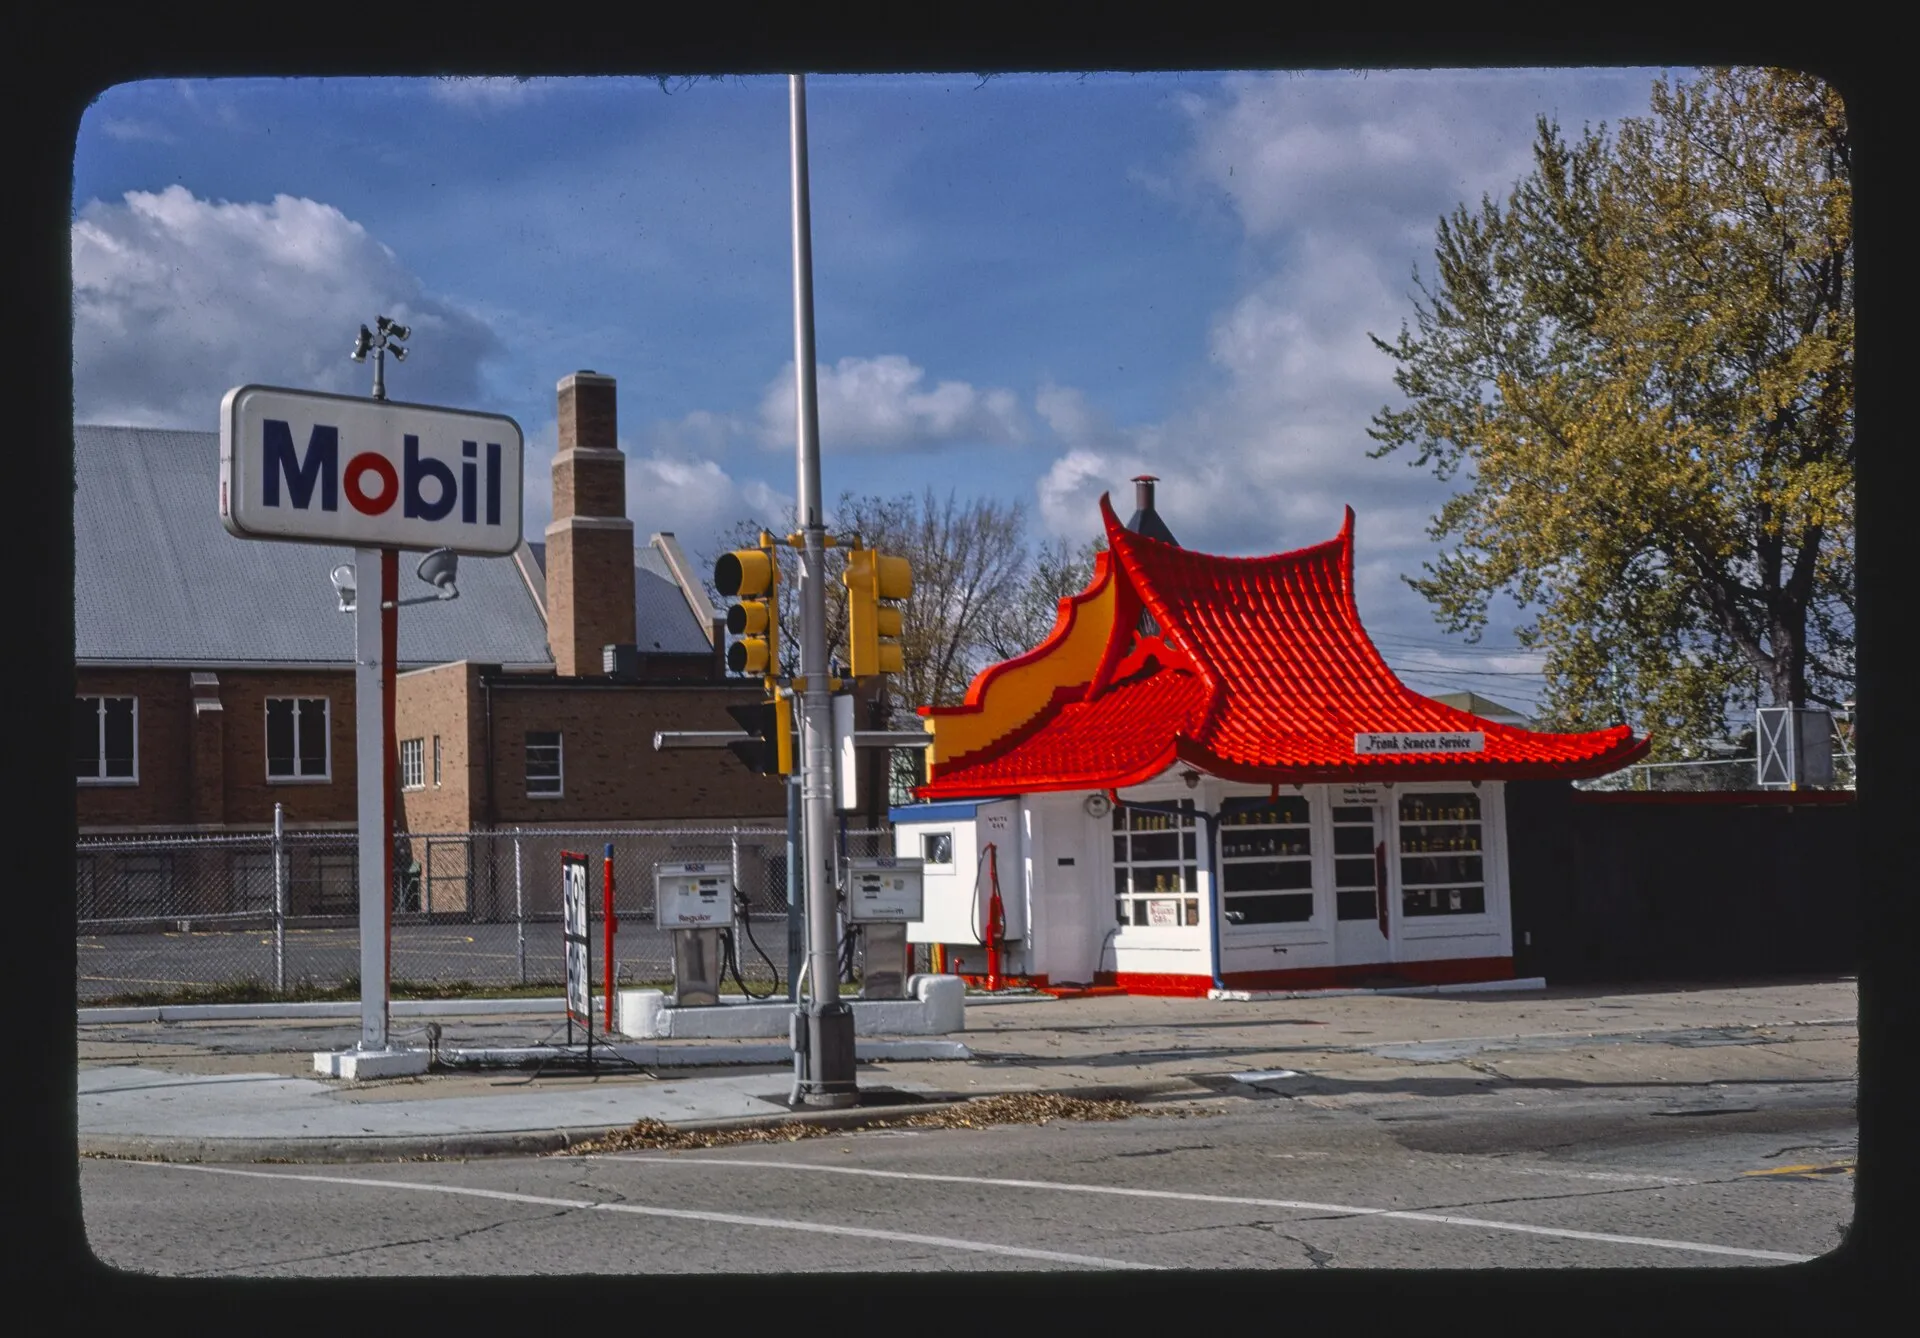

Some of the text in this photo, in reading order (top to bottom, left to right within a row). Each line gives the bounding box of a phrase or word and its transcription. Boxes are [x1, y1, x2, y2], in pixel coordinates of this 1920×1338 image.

[263, 419, 501, 526] Mobil
[1365, 735, 1472, 751] Frank Seneca Service
[678, 914, 711, 924] Regular
